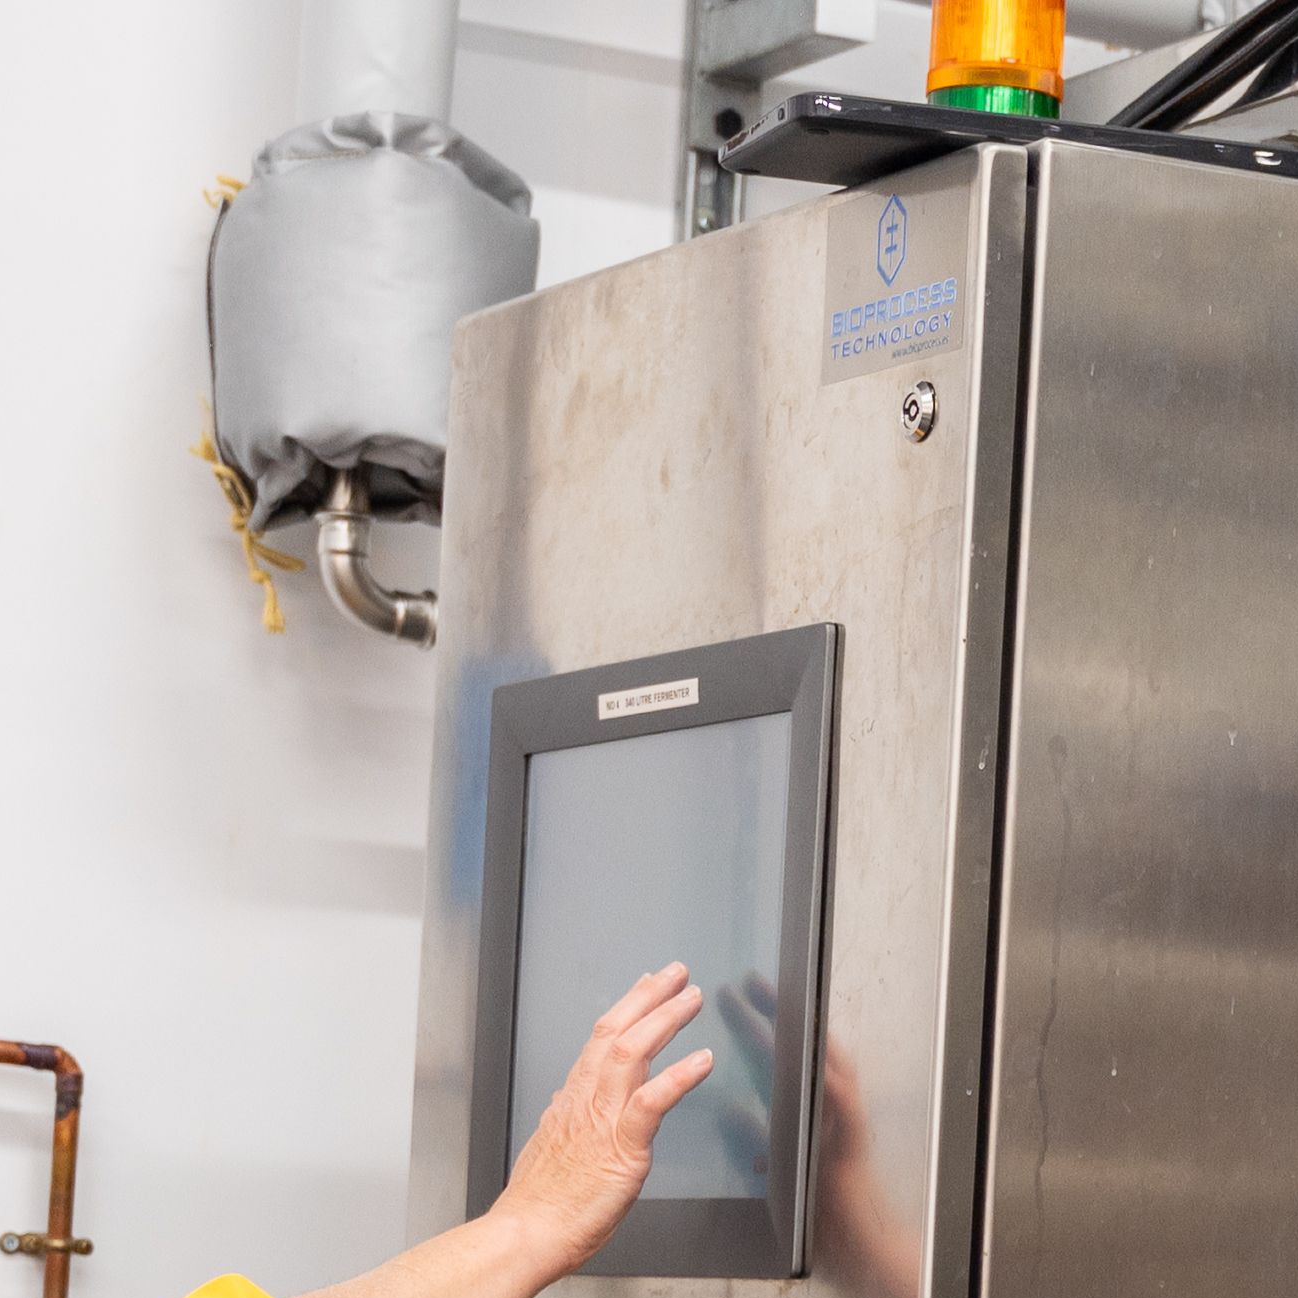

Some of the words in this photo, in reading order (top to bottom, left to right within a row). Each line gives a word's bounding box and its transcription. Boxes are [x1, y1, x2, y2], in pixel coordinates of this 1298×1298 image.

[831, 278, 957, 338] BIOPROCESS
[831, 310, 952, 360] TECHNOLOGY
[653, 687, 690, 703] FERMENTER
